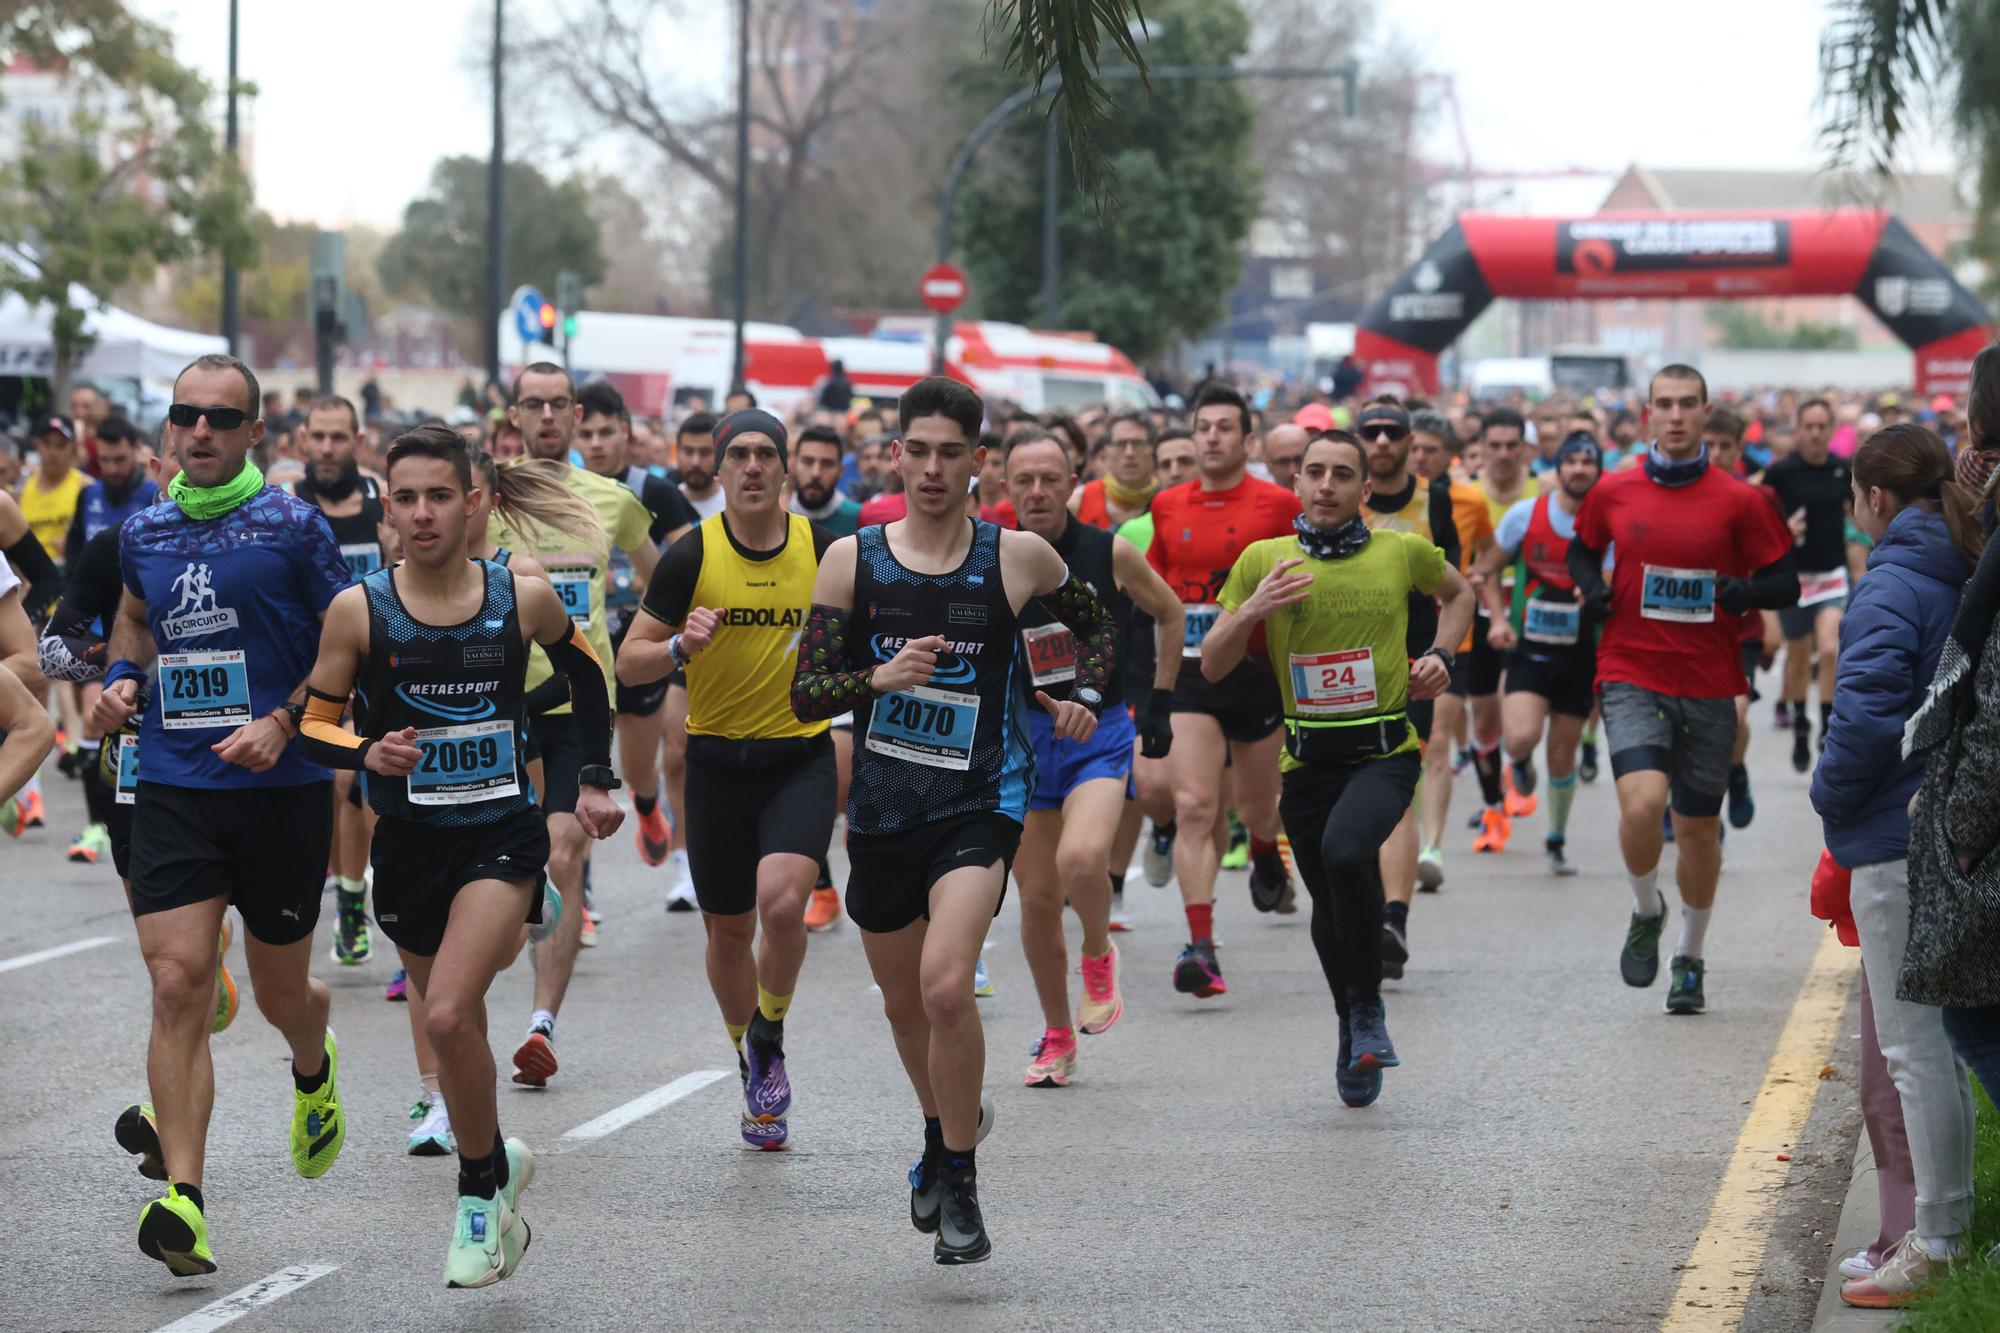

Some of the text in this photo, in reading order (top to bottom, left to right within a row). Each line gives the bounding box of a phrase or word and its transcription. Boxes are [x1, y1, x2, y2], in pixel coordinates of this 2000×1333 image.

[1653, 577, 1703, 600] 2040
[166, 622, 183, 637] 16
[181, 613, 228, 629] CIRCUITO
[721, 608, 802, 627] REDOLAT
[881, 636, 985, 655] MEPORT
[171, 667, 229, 699] 2319
[409, 681, 500, 695] METAESPORT
[1321, 666, 1356, 689] 24
[886, 695, 955, 737] 2070
[420, 737, 497, 773] 2069
